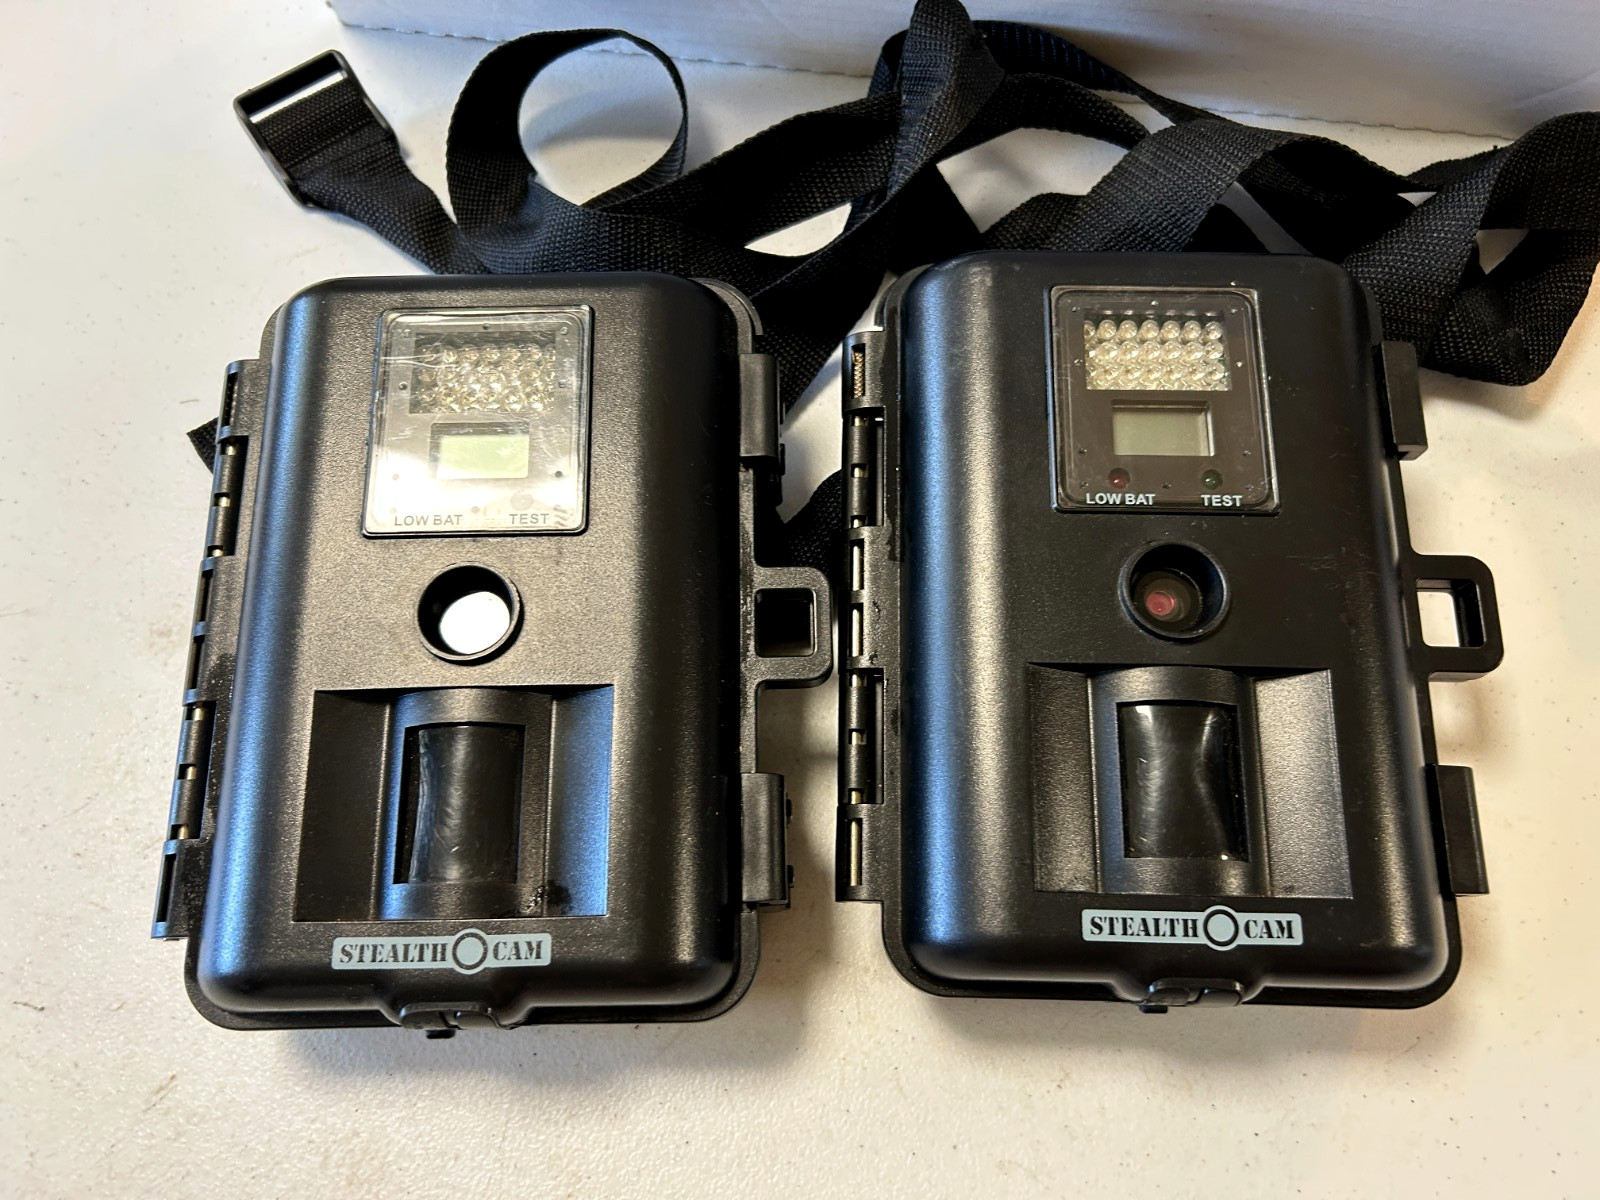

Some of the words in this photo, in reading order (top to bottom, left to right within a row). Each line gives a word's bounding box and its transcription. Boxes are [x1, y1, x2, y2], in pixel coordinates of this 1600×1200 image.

[1085, 493, 1123, 505] LOW
[1125, 493, 1156, 505] BAT
[1200, 494, 1243, 507] TEST
[394, 514, 430, 526] LOW
[432, 514, 464, 526] BAT
[509, 513, 550, 525] TEST
[1089, 915, 1200, 938] STEALTH
[1243, 919, 1295, 939] CAM
[339, 942, 448, 963] STEALTH
[492, 939, 543, 961] CAM
